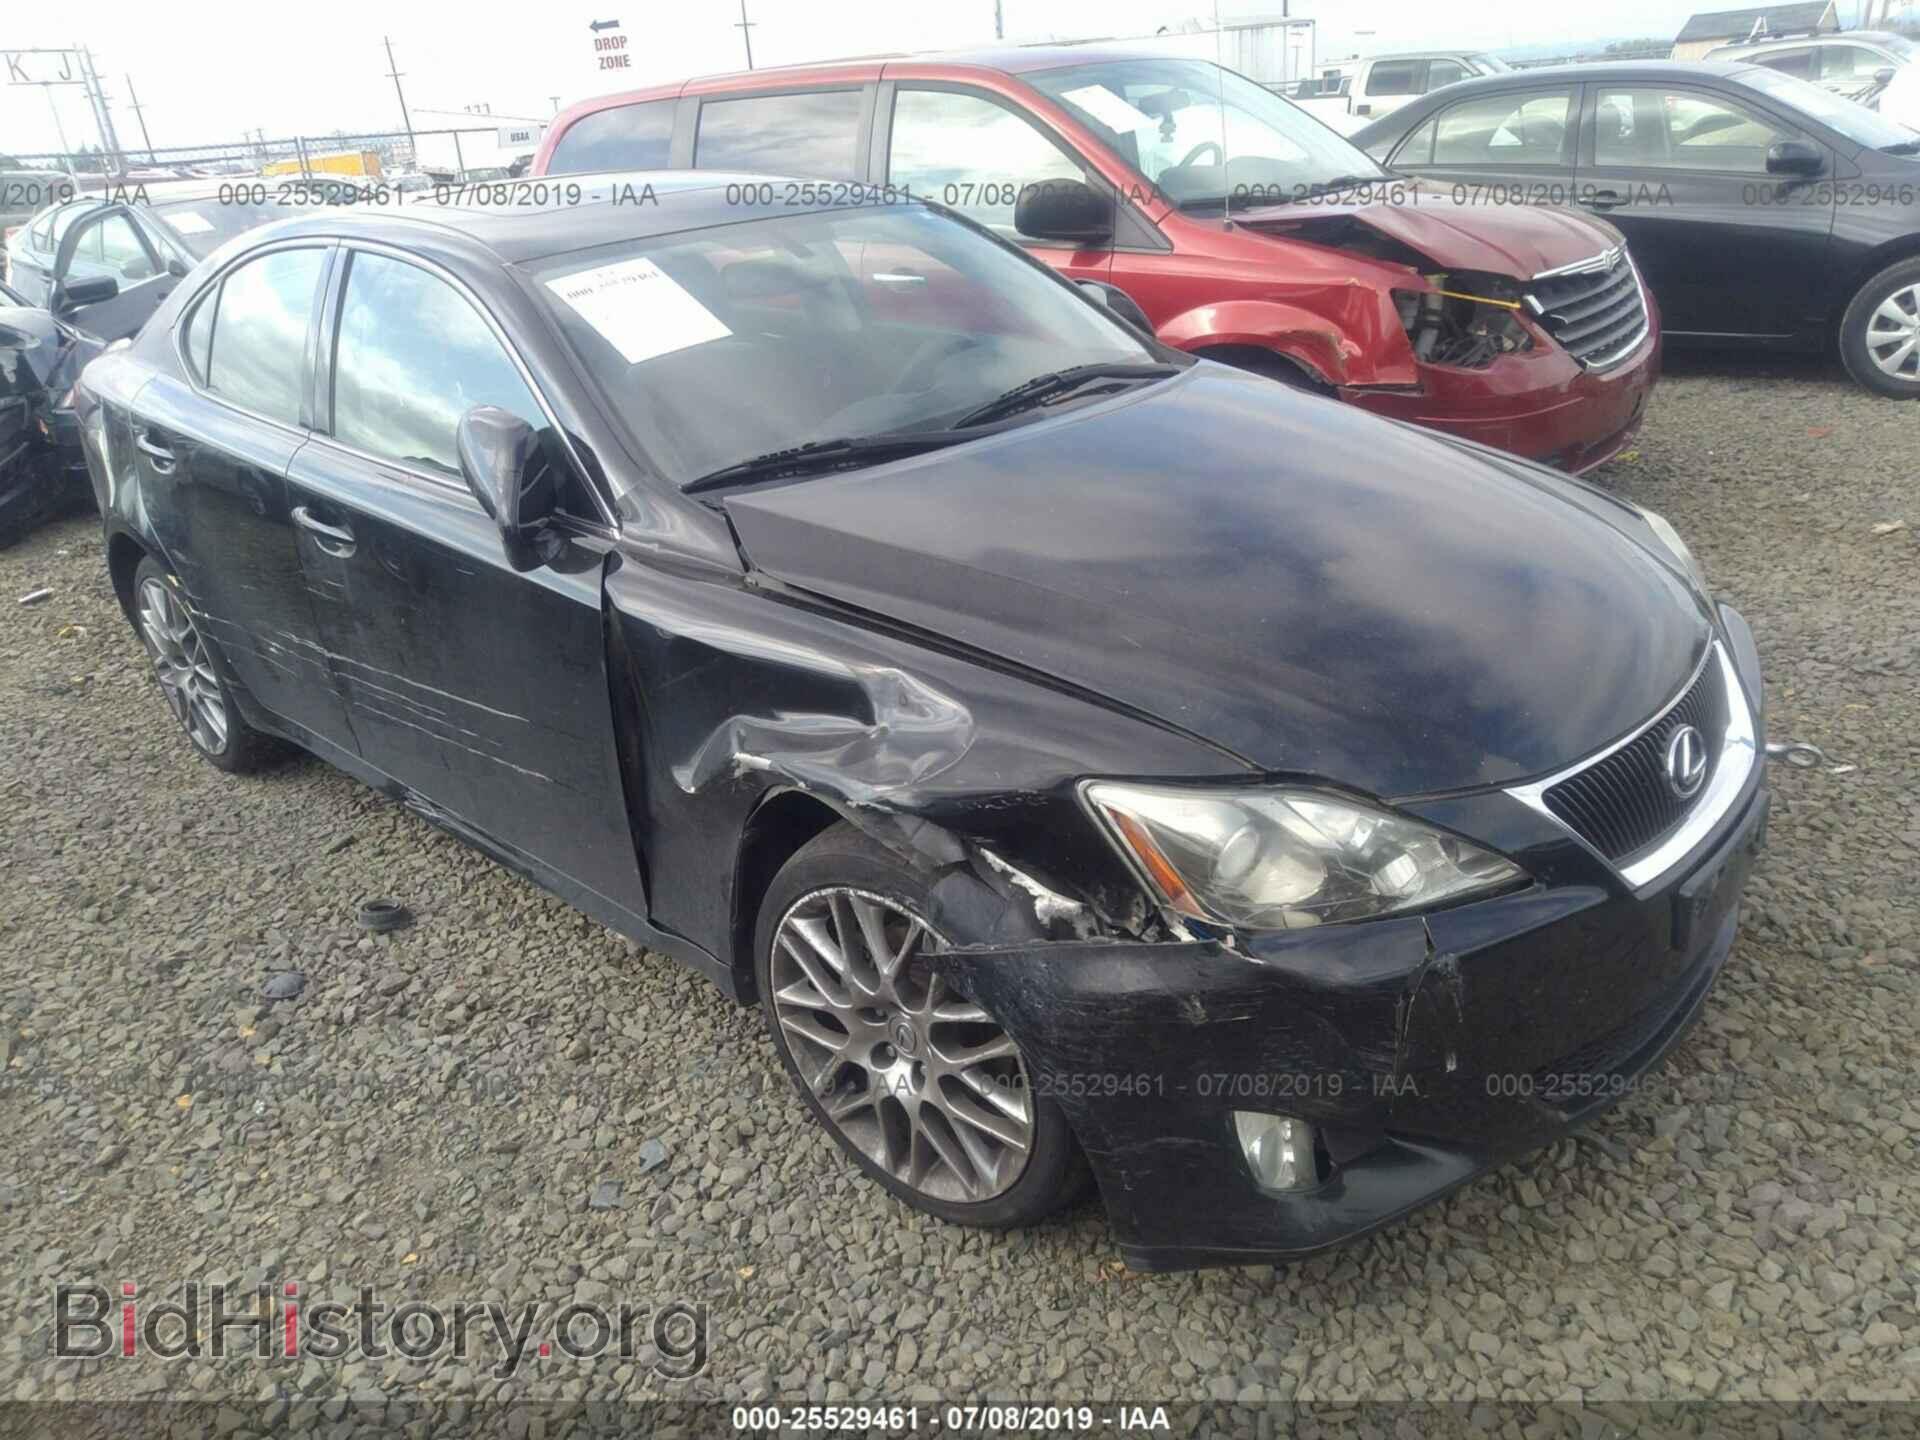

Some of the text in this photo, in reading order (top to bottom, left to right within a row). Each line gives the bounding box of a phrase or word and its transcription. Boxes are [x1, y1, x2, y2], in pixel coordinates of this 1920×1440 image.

[594, 35, 628, 51] DROP
[5, 52, 72, 82] K J
[598, 54, 632, 71] ZONE
[510, 132, 530, 142] USAA
